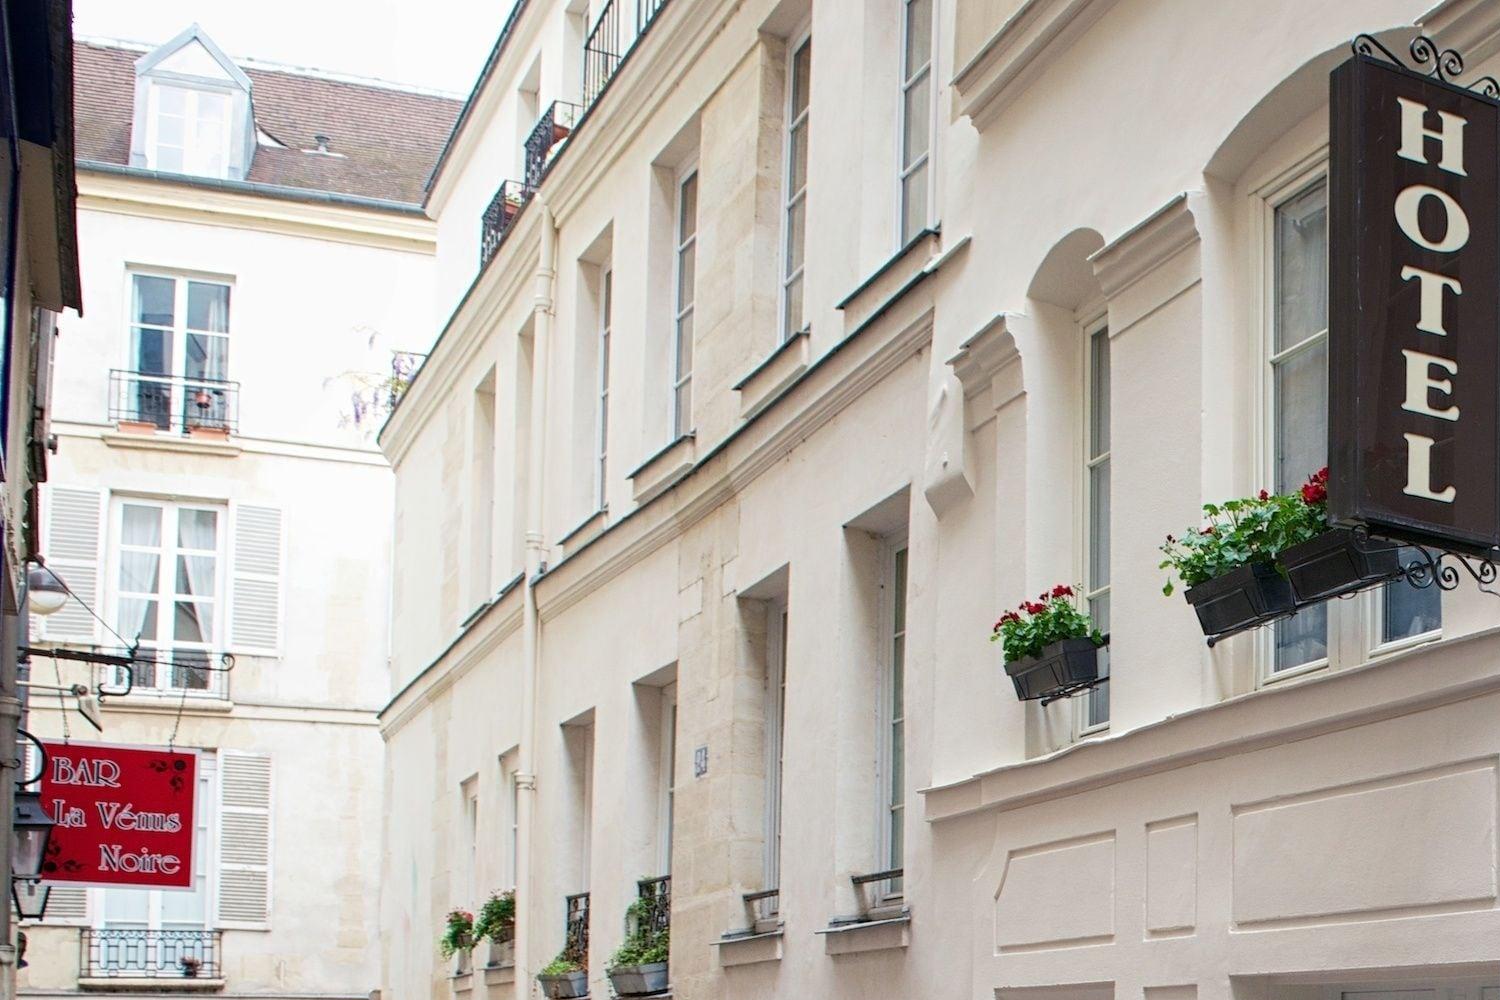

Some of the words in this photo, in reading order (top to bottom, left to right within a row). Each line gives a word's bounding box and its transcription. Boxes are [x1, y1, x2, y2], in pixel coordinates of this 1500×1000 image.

[1393, 96, 1471, 504] HOTEL
[52, 756, 121, 788] BAR
[53, 799, 86, 828] La
[96, 801, 182, 833] Vénus
[98, 844, 181, 874] Noire
